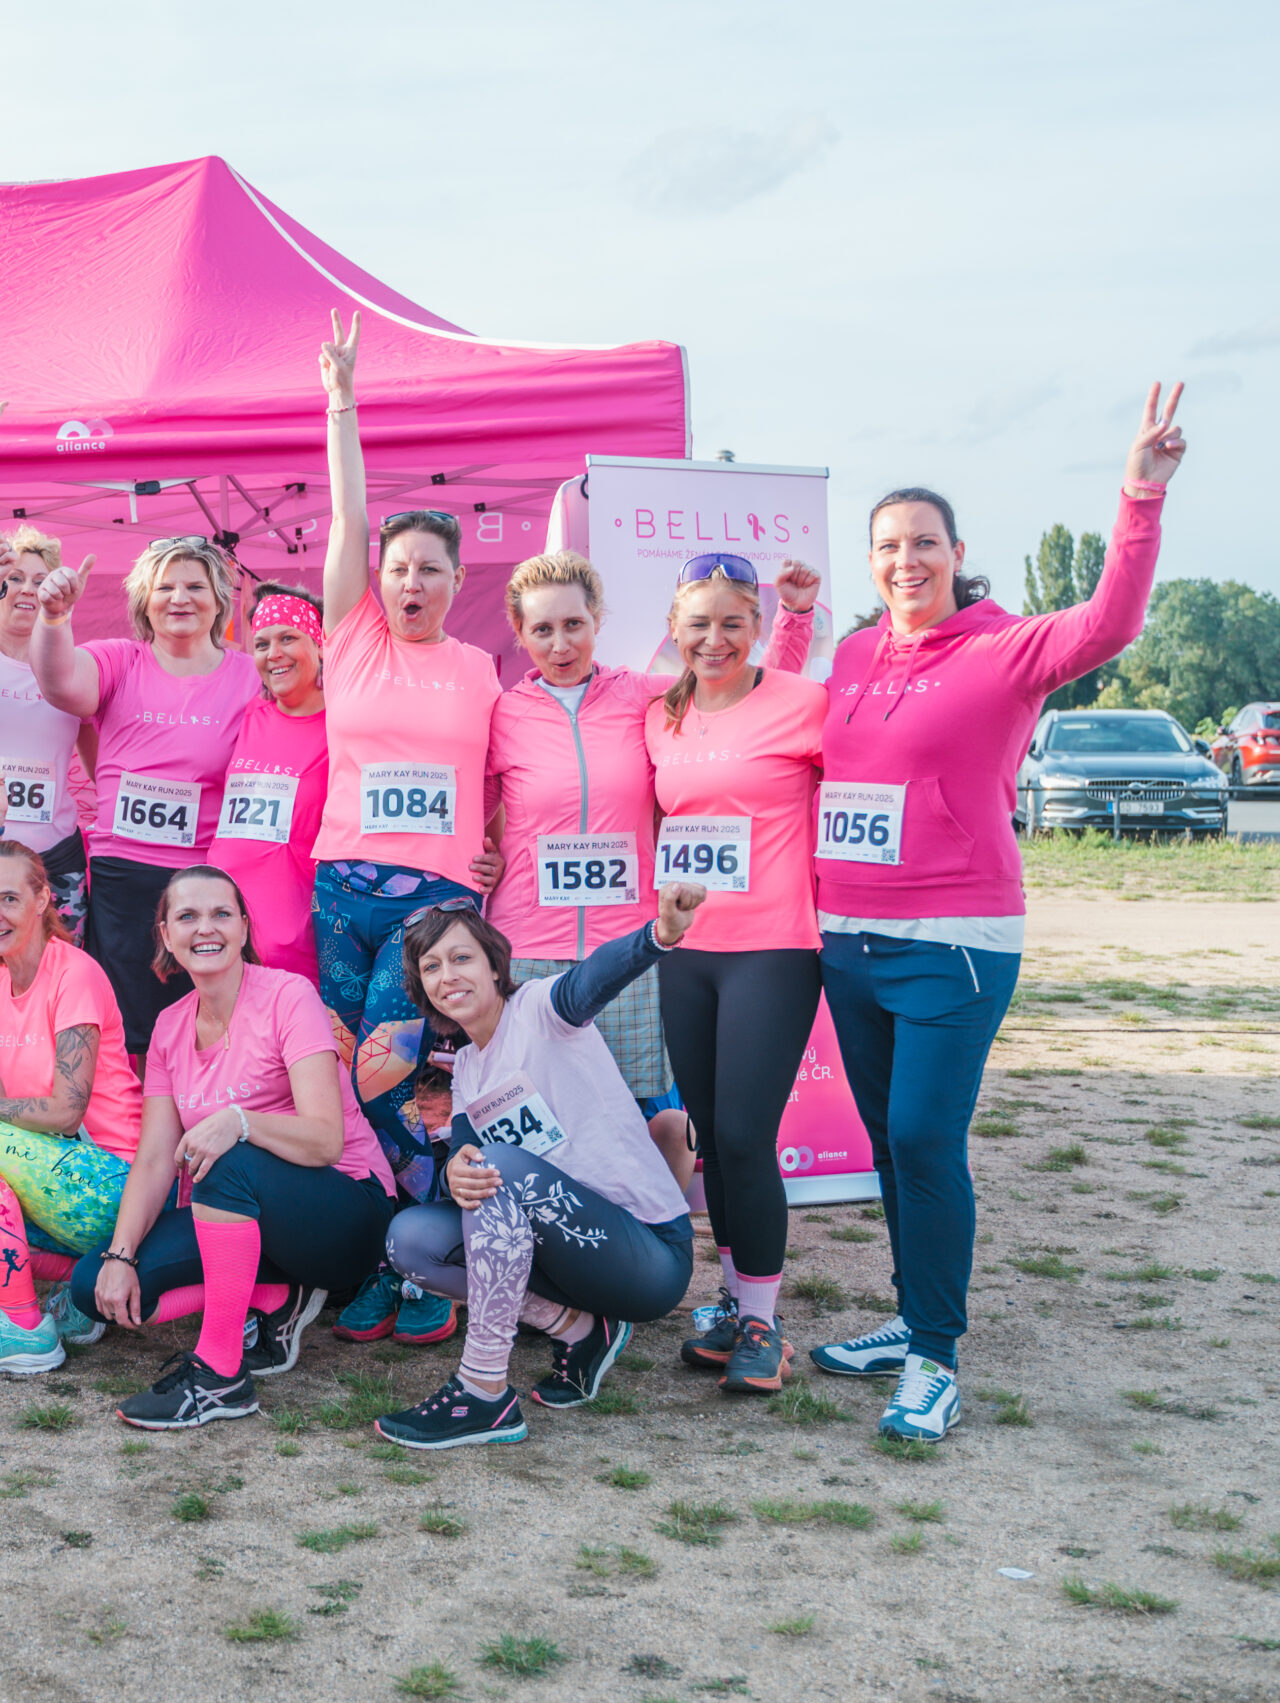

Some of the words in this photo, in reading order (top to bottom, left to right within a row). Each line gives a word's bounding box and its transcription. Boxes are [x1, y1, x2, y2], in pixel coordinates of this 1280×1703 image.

[56, 440, 106, 452] aliance
[635, 508, 791, 543] BELLIS
[143, 711, 211, 726] BELLIS
[2, 764, 16, 772] KAY
[17, 765, 34, 774] RUN
[34, 767, 50, 775] 2025
[368, 770, 392, 779] MARY
[394, 770, 410, 778] KAY
[412, 770, 429, 779] RUN
[430, 771, 448, 780] 2025
[125, 780, 143, 789] MARY
[143, 783, 157, 792] KAY
[157, 785, 174, 795] RUN
[174, 788, 192, 797] 2025
[272, 782, 289, 790] 2025
[8, 781, 45, 809] 86
[366, 787, 449, 819] 1084
[843, 792, 856, 800] KAY
[120, 795, 188, 831] 1664
[228, 797, 280, 827] 1221
[666, 825, 683, 833] MARY
[685, 825, 699, 833] KAY
[701, 825, 719, 833] RUN
[720, 825, 741, 833] 2025
[824, 811, 890, 847] 1056
[573, 842, 590, 850] KAY
[592, 841, 610, 849] RUN
[610, 840, 629, 849] 2025
[660, 843, 738, 875] 1496
[545, 859, 627, 890] 1582
[812, 1064, 834, 1080] ČR.
[491, 1095, 506, 1109] RUN
[504, 1084, 524, 1101] 2025
[481, 1105, 543, 1147] 1534
[818, 1150, 848, 1159] aliance
